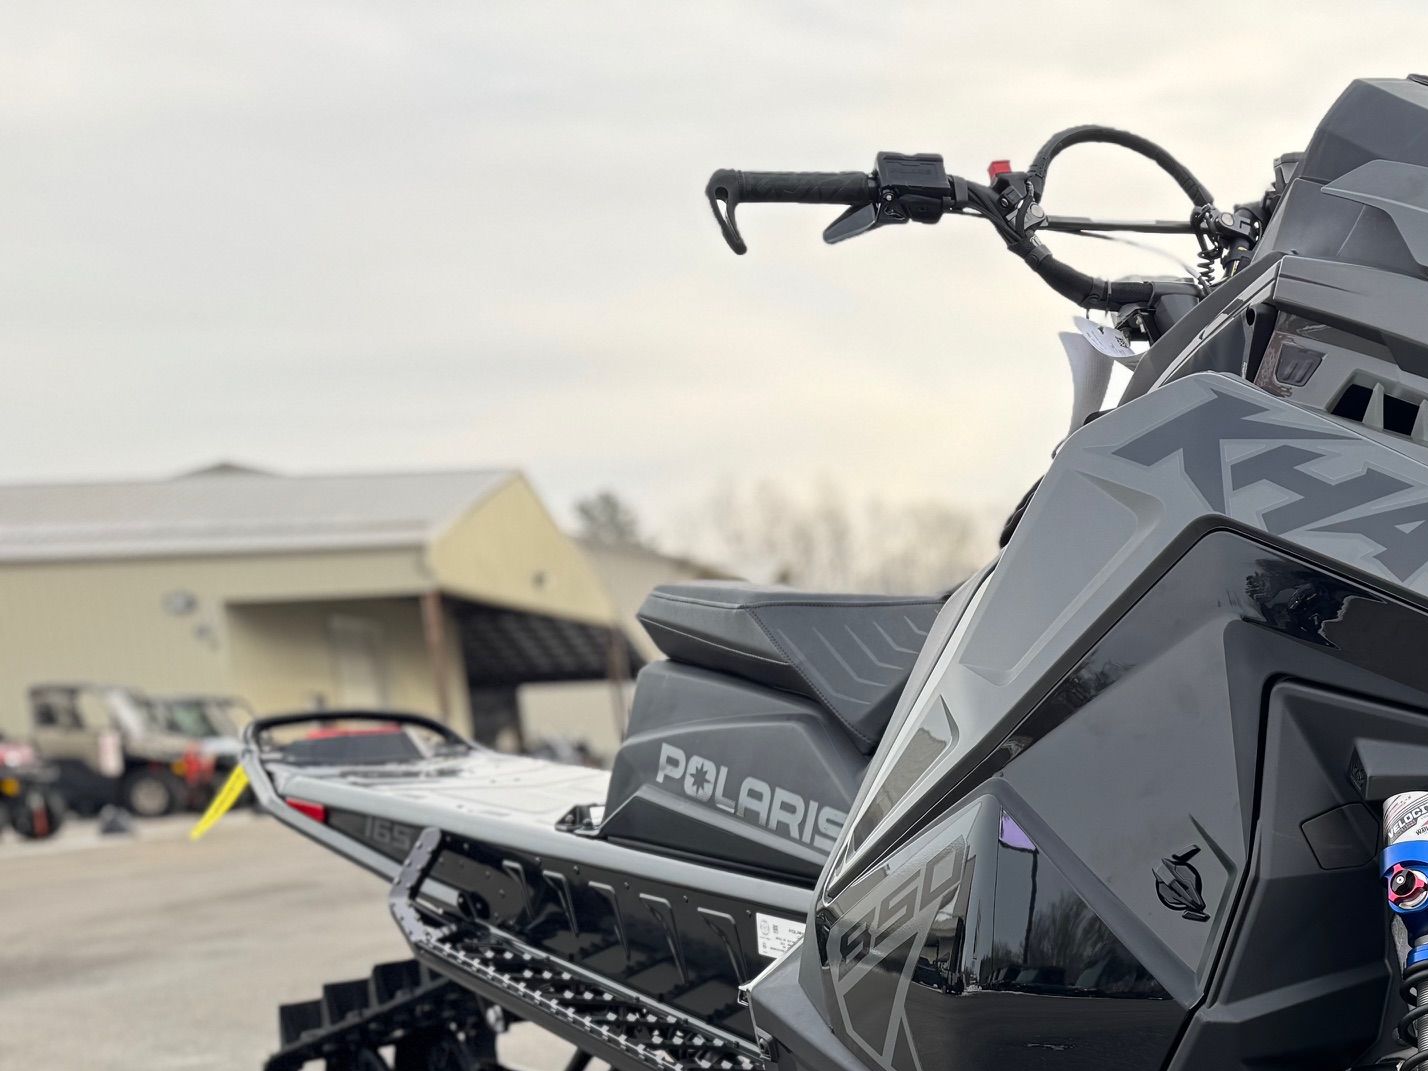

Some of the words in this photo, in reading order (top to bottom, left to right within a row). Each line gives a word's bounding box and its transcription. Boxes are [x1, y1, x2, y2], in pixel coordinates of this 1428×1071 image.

[365, 815, 411, 850] 165
[656, 742, 849, 851] POLARIS
[838, 835, 965, 982] 850
